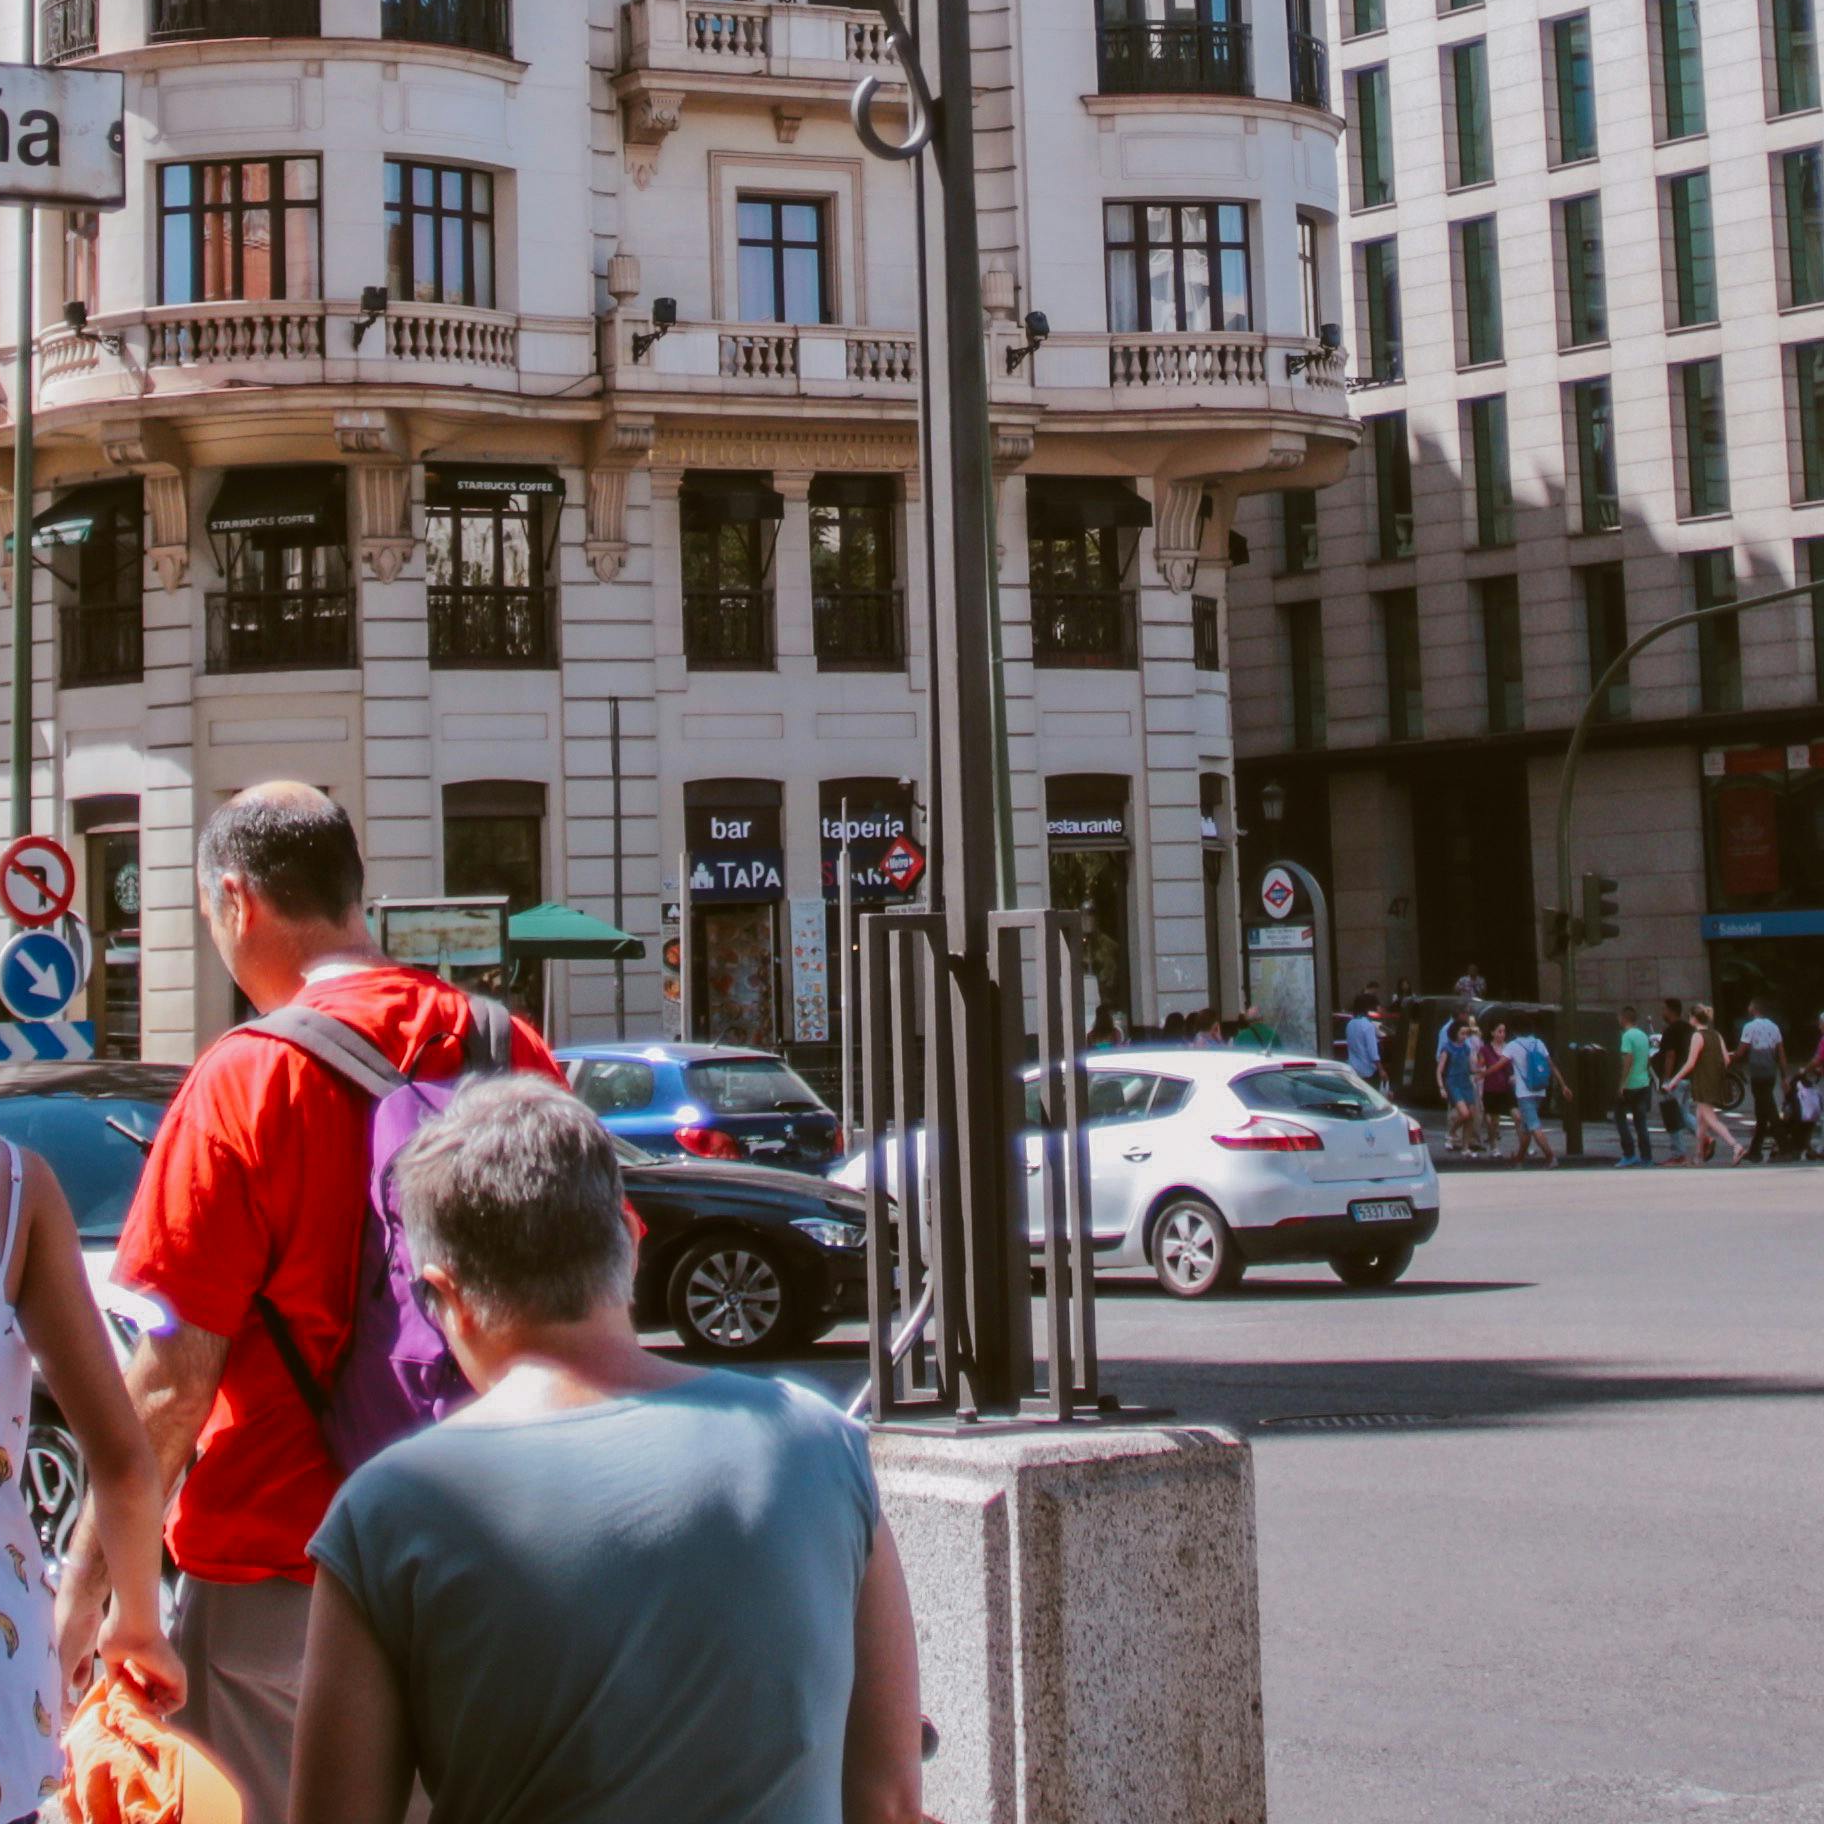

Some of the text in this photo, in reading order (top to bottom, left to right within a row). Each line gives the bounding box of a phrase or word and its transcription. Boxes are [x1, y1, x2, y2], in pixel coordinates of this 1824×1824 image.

[457, 479, 553, 492] STARBUCKS COFFEE
[211, 513, 316, 530] STARBUCKS COFFEE
[711, 817, 752, 840] bar
[1047, 817, 1123, 835] estaurante
[1387, 897, 1410, 919] 47
[1719, 921, 1762, 937] Sabadell
